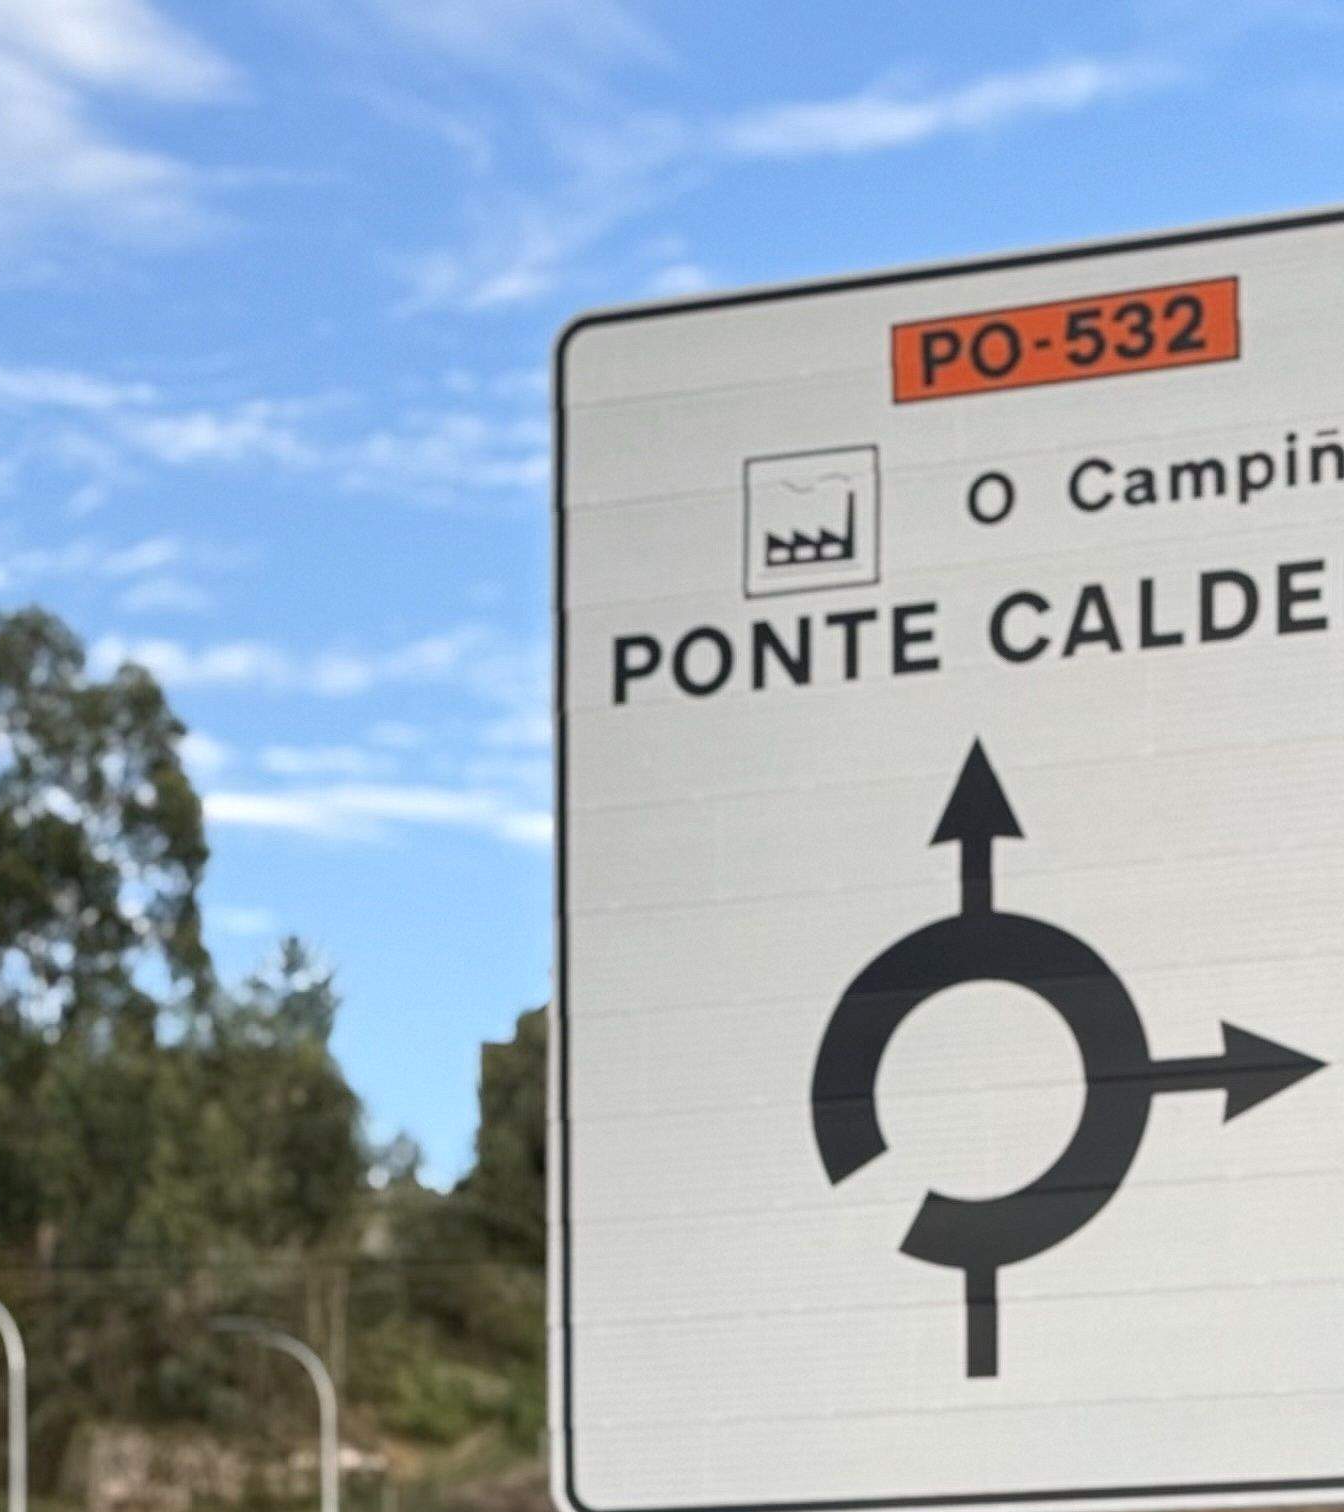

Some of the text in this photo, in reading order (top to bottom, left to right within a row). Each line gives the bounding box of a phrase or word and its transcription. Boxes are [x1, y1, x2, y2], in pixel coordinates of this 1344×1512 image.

[919, 294, 1208, 387] PO-532
[967, 471, 1016, 525] O
[611, 602, 941, 705] PONTE
